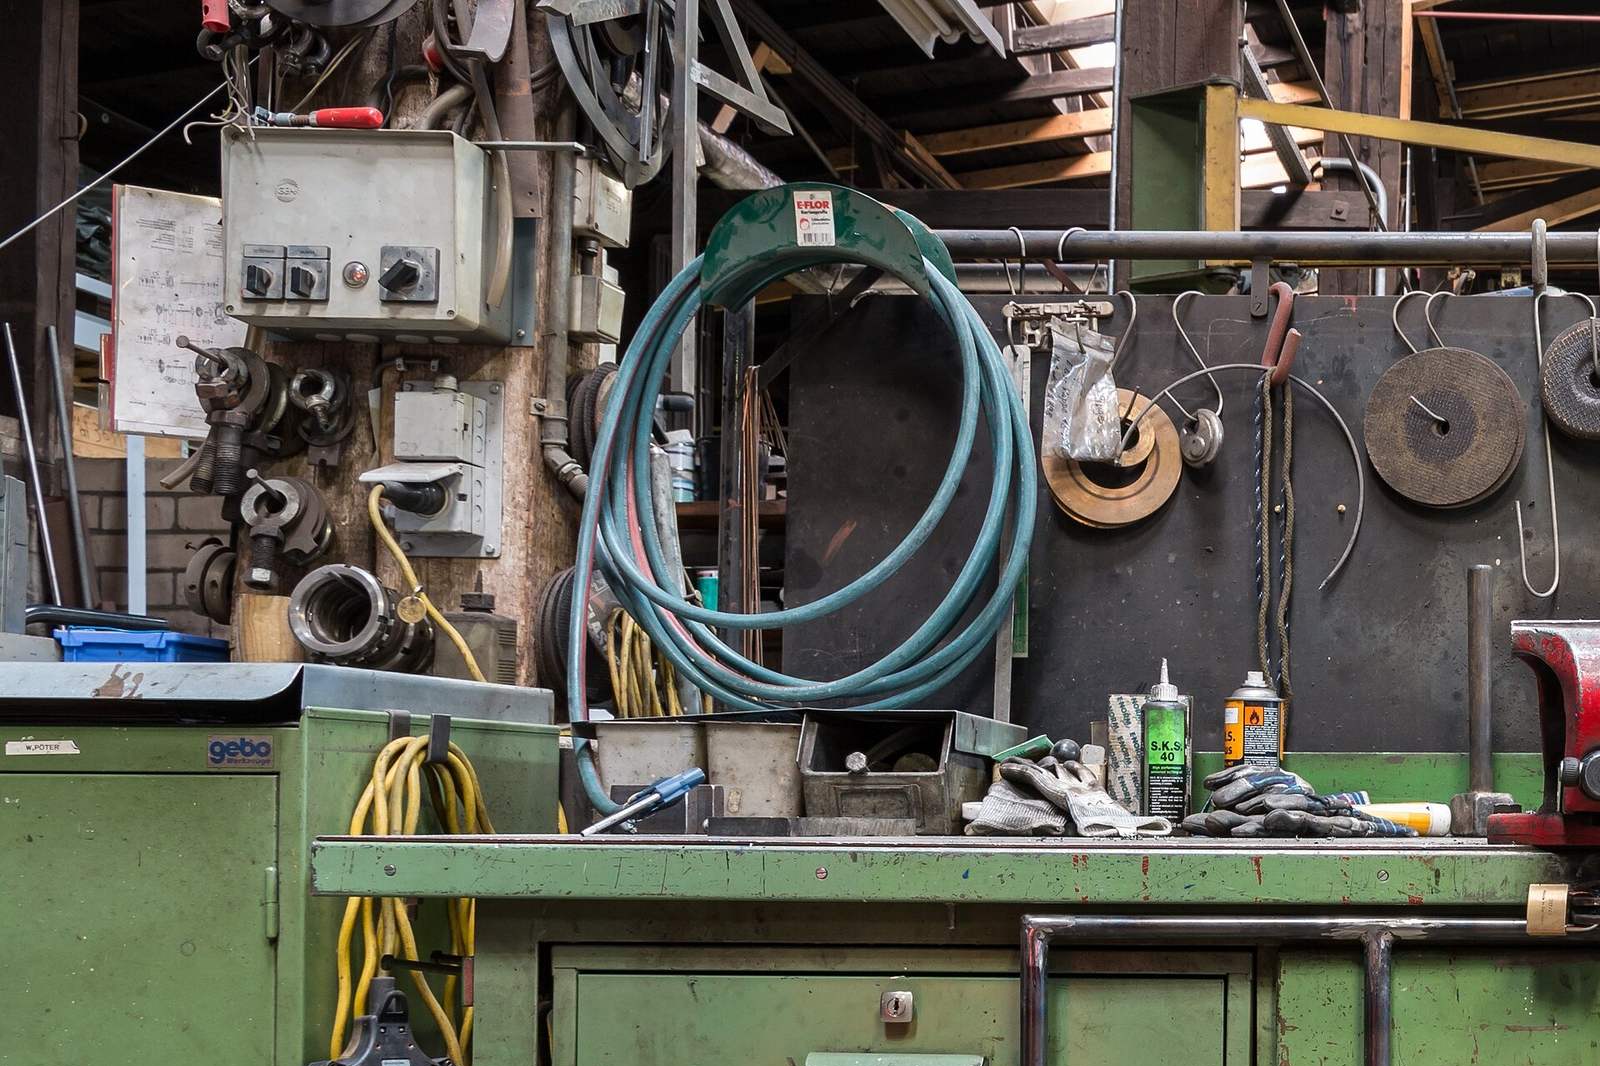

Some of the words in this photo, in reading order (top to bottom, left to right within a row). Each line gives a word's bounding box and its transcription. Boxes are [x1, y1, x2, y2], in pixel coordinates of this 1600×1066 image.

[796, 200, 830, 209] E-FLOR
[209, 737, 272, 764] gebo
[1150, 740, 1183, 751] S.K.S.
[1160, 752, 1175, 762] 40
